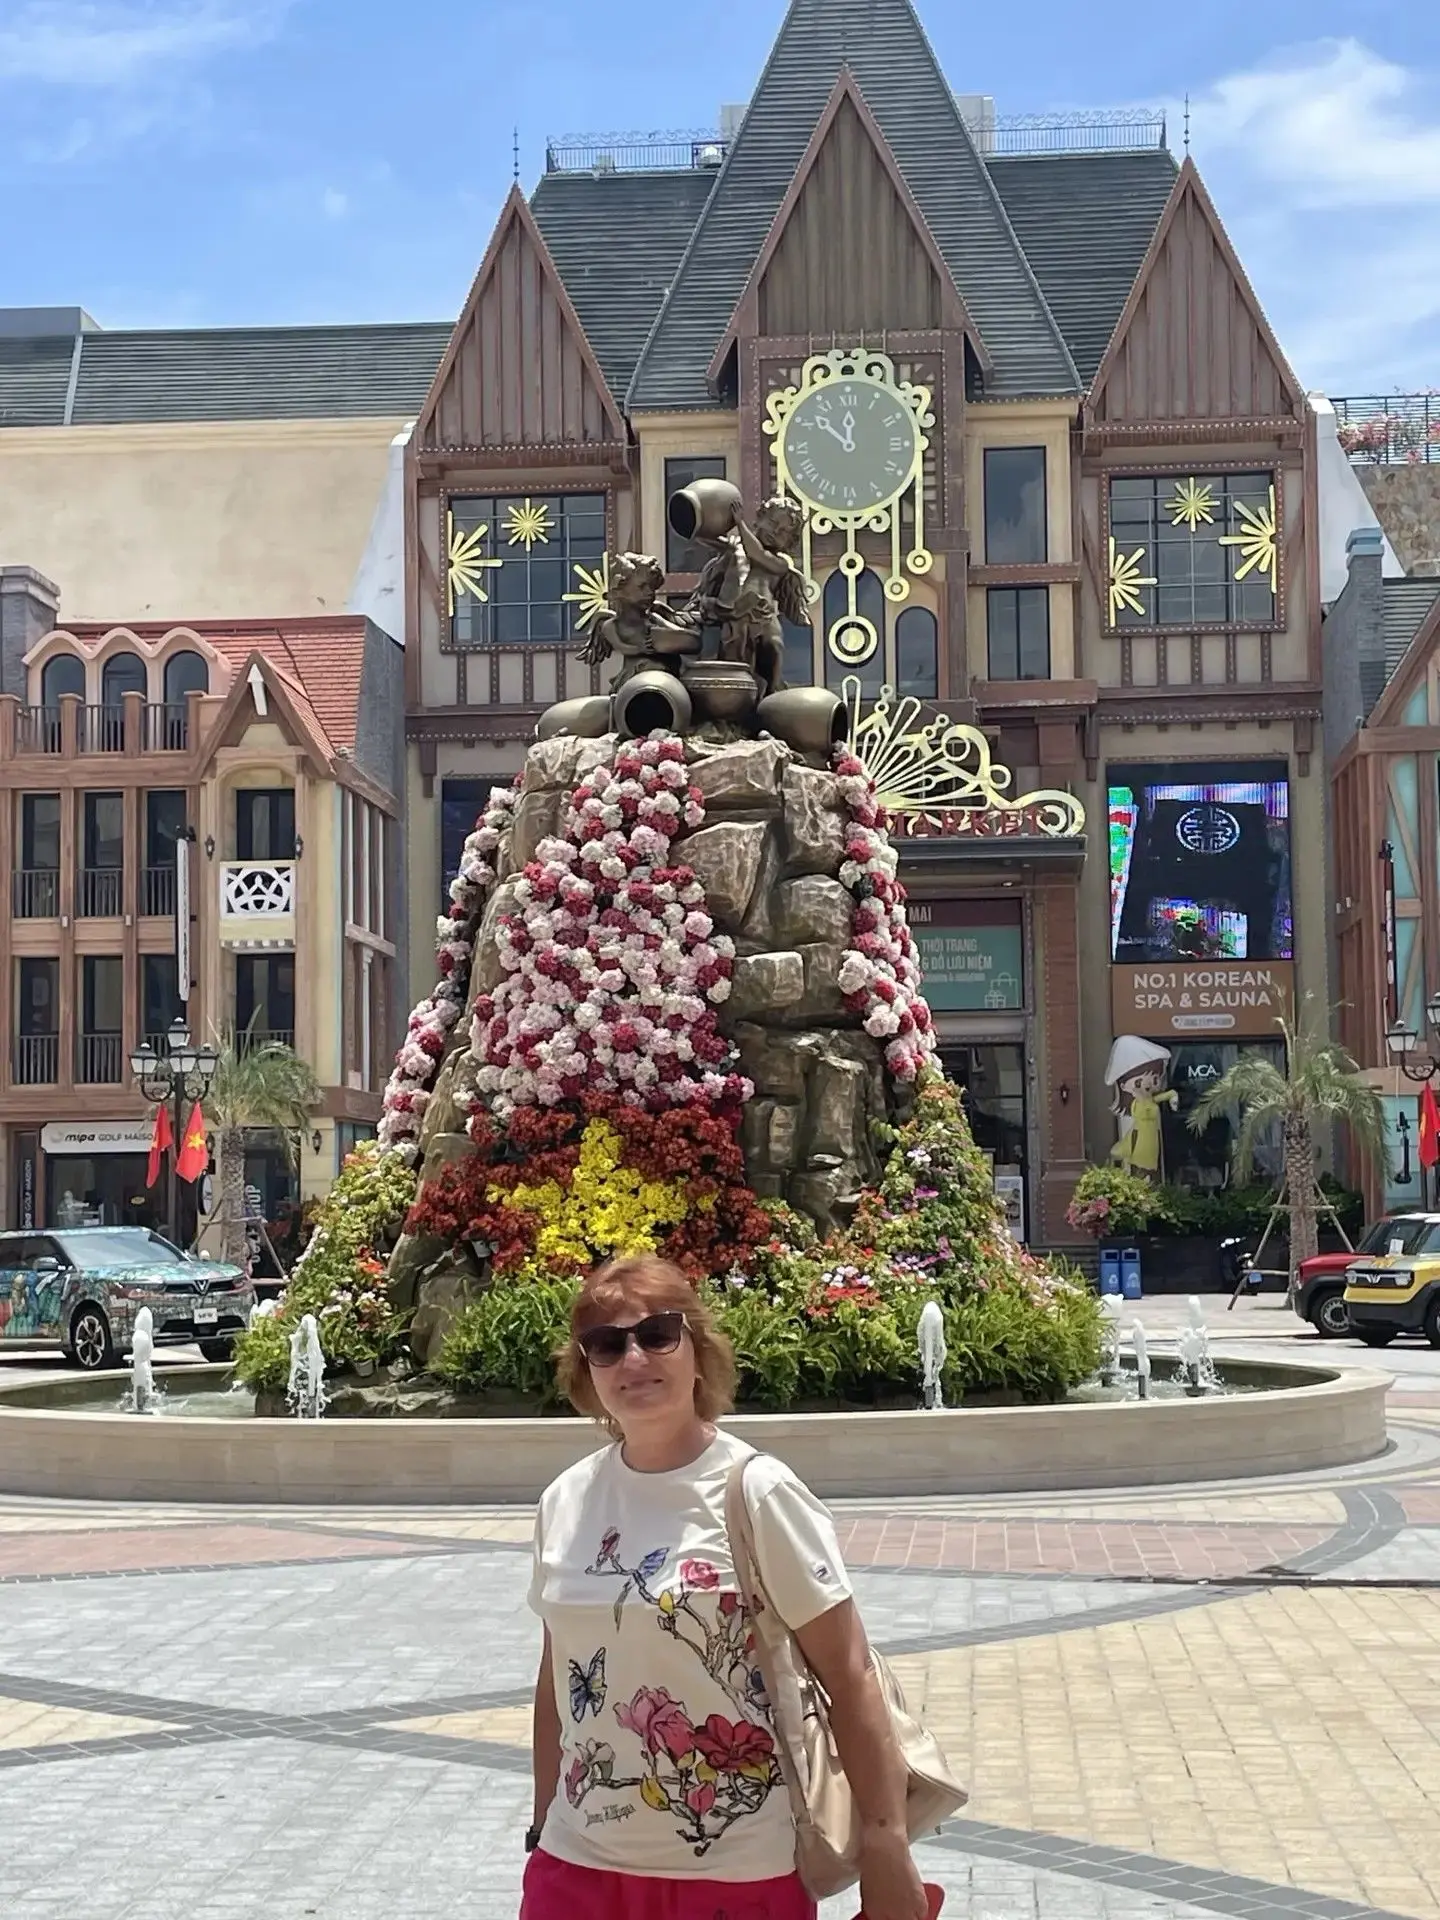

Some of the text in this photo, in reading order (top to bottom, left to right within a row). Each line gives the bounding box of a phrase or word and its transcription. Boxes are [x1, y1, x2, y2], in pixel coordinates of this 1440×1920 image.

[839, 394, 858, 407] XII
[890, 437, 902, 451] III
[945, 938, 978, 953] TRANG
[1133, 970, 1272, 989] NO.1 KOREAN
[1135, 991, 1272, 1009] SPA & SAUNA
[1188, 1064, 1217, 1078] MCA
[64, 1132, 157, 1143] mipa GOLF MAISO
